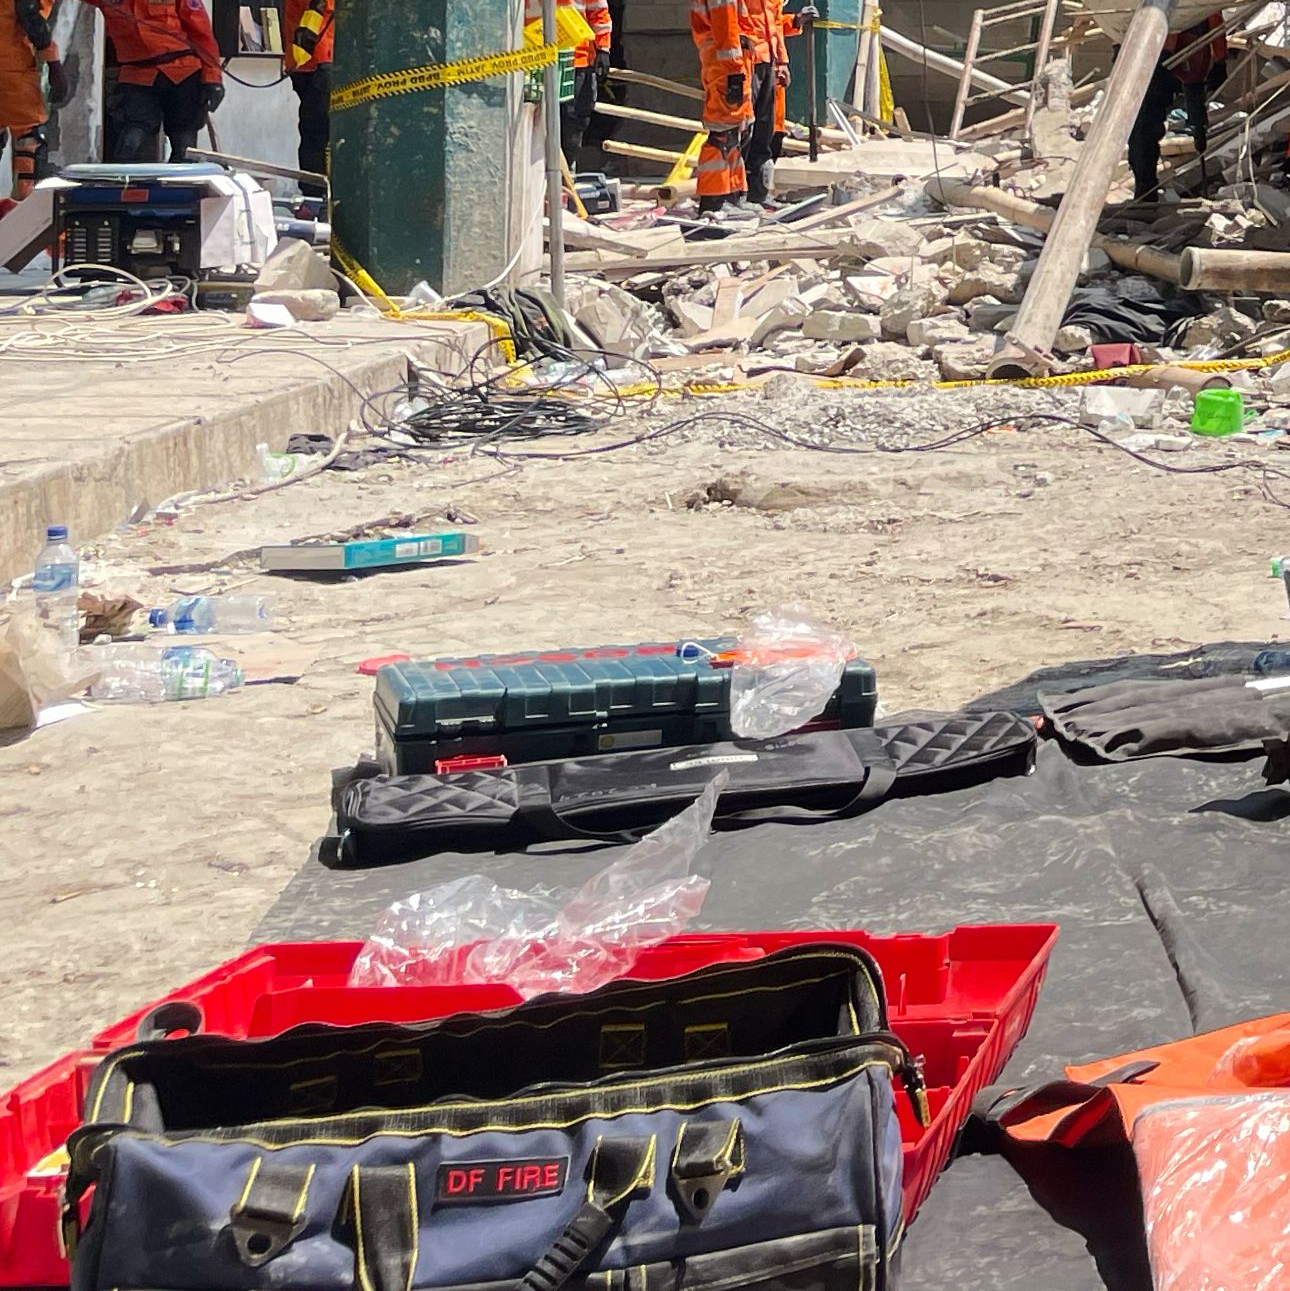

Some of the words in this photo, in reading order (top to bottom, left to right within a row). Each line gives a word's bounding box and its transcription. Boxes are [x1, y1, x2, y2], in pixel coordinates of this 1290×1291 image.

[411, 72, 441, 86] BPBD
[447, 1169, 486, 1193] DF
[496, 1164, 560, 1191] FIRE
